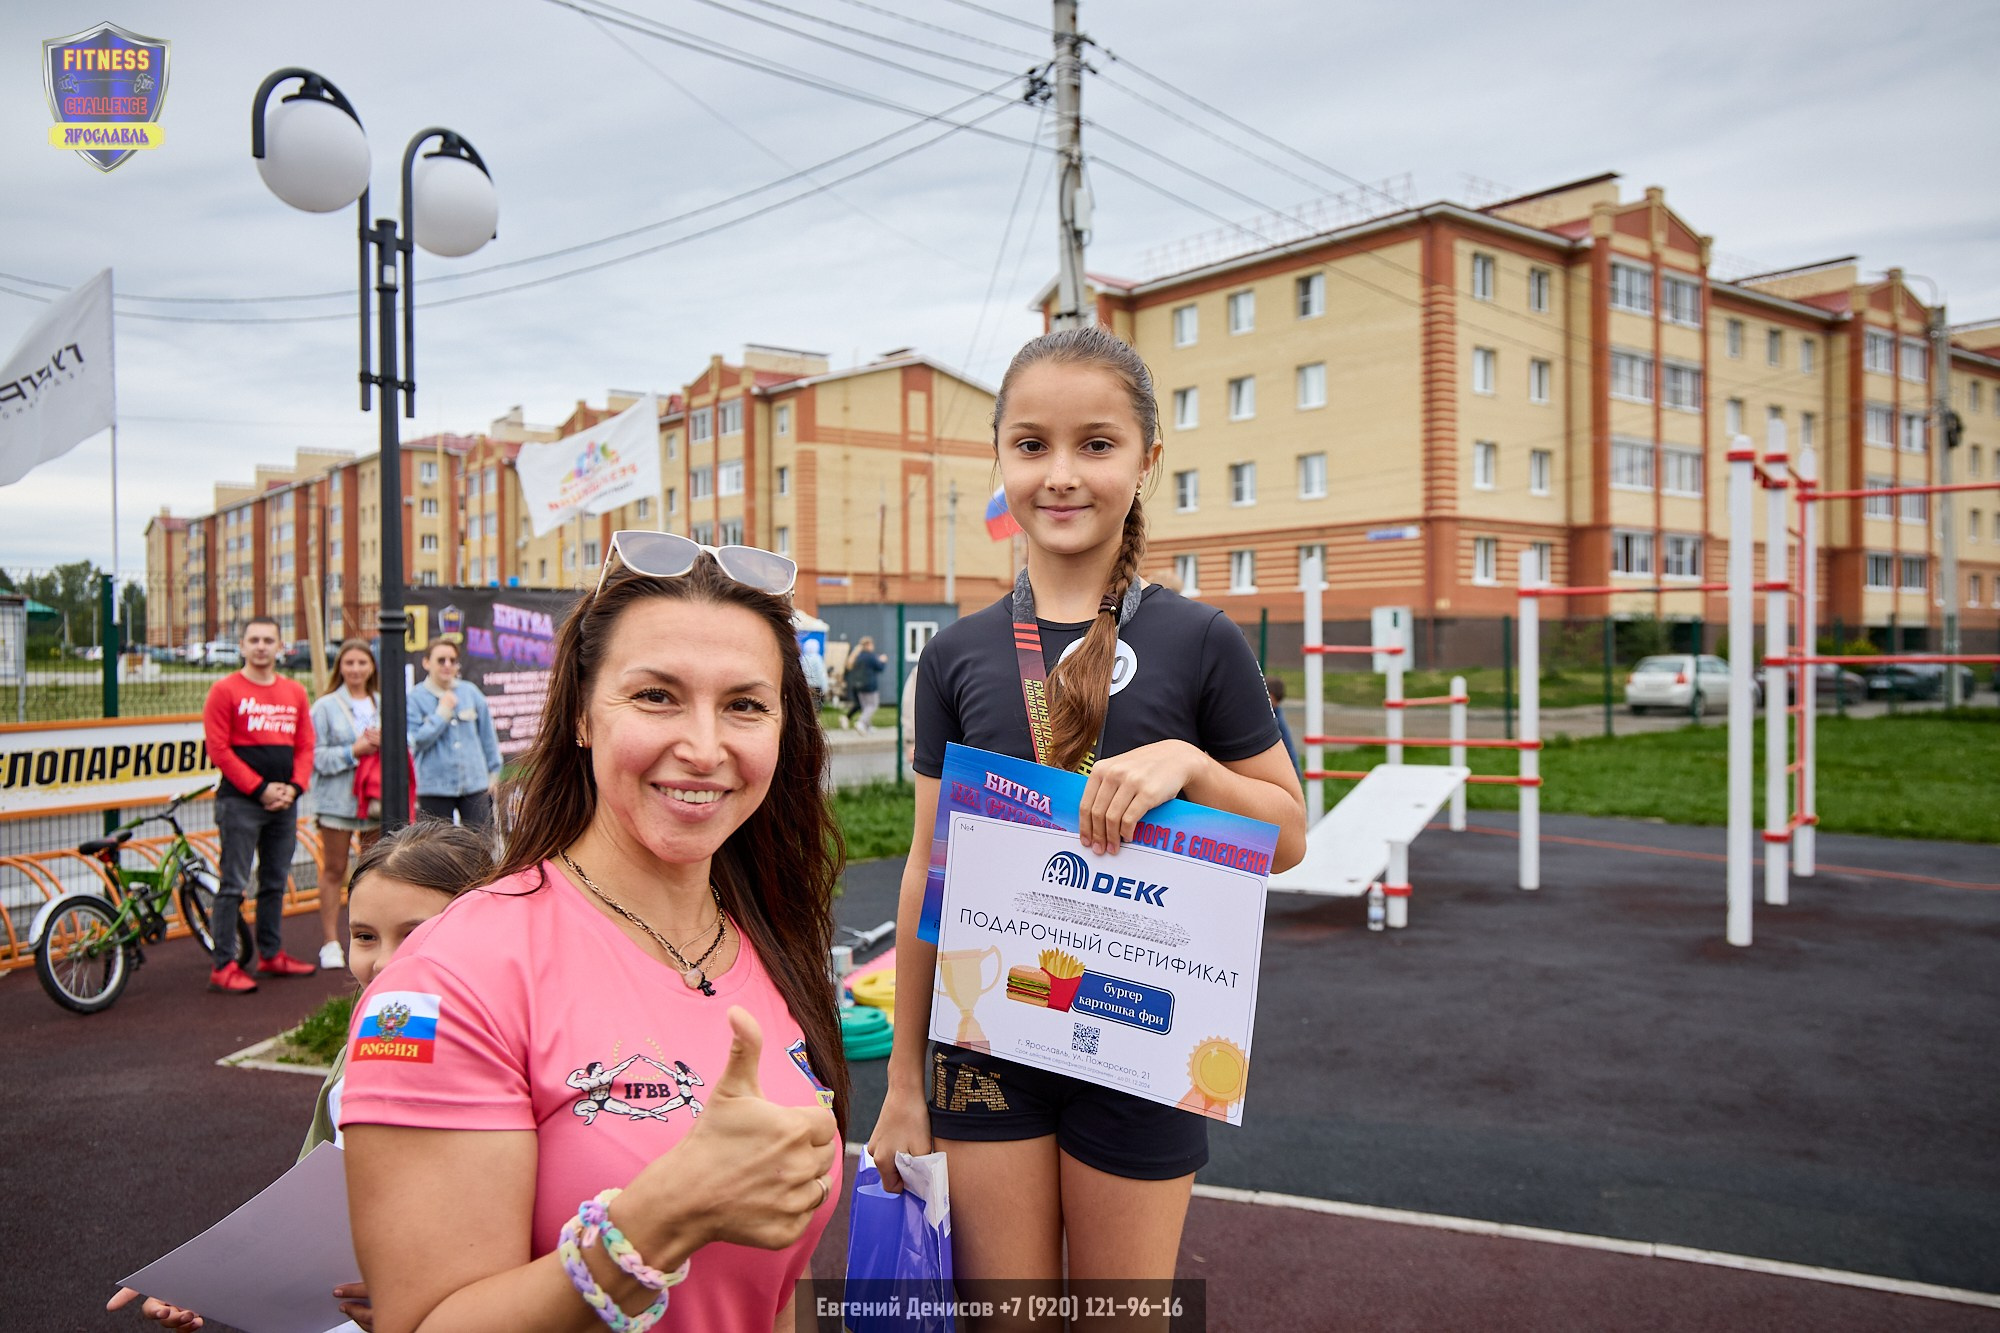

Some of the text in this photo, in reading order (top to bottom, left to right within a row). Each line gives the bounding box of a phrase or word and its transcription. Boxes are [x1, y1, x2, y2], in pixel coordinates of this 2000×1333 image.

[0, 740, 217, 789] ЛОПАРКОВ
[950, 782, 981, 809] НА
[983, 770, 1052, 816] БИТВА
[1173, 831, 1185, 853] 2
[959, 908, 1240, 988] ПОДАРОЧНЫЙ СЕРТИФИКАТ
[1103, 982, 1143, 1004] бургер
[1078, 995, 1164, 1026] картошка фри
[359, 1042, 419, 1058] РОССИЯ
[1141, 1071, 1150, 1080] 21
[624, 1083, 671, 1099] IFBB
